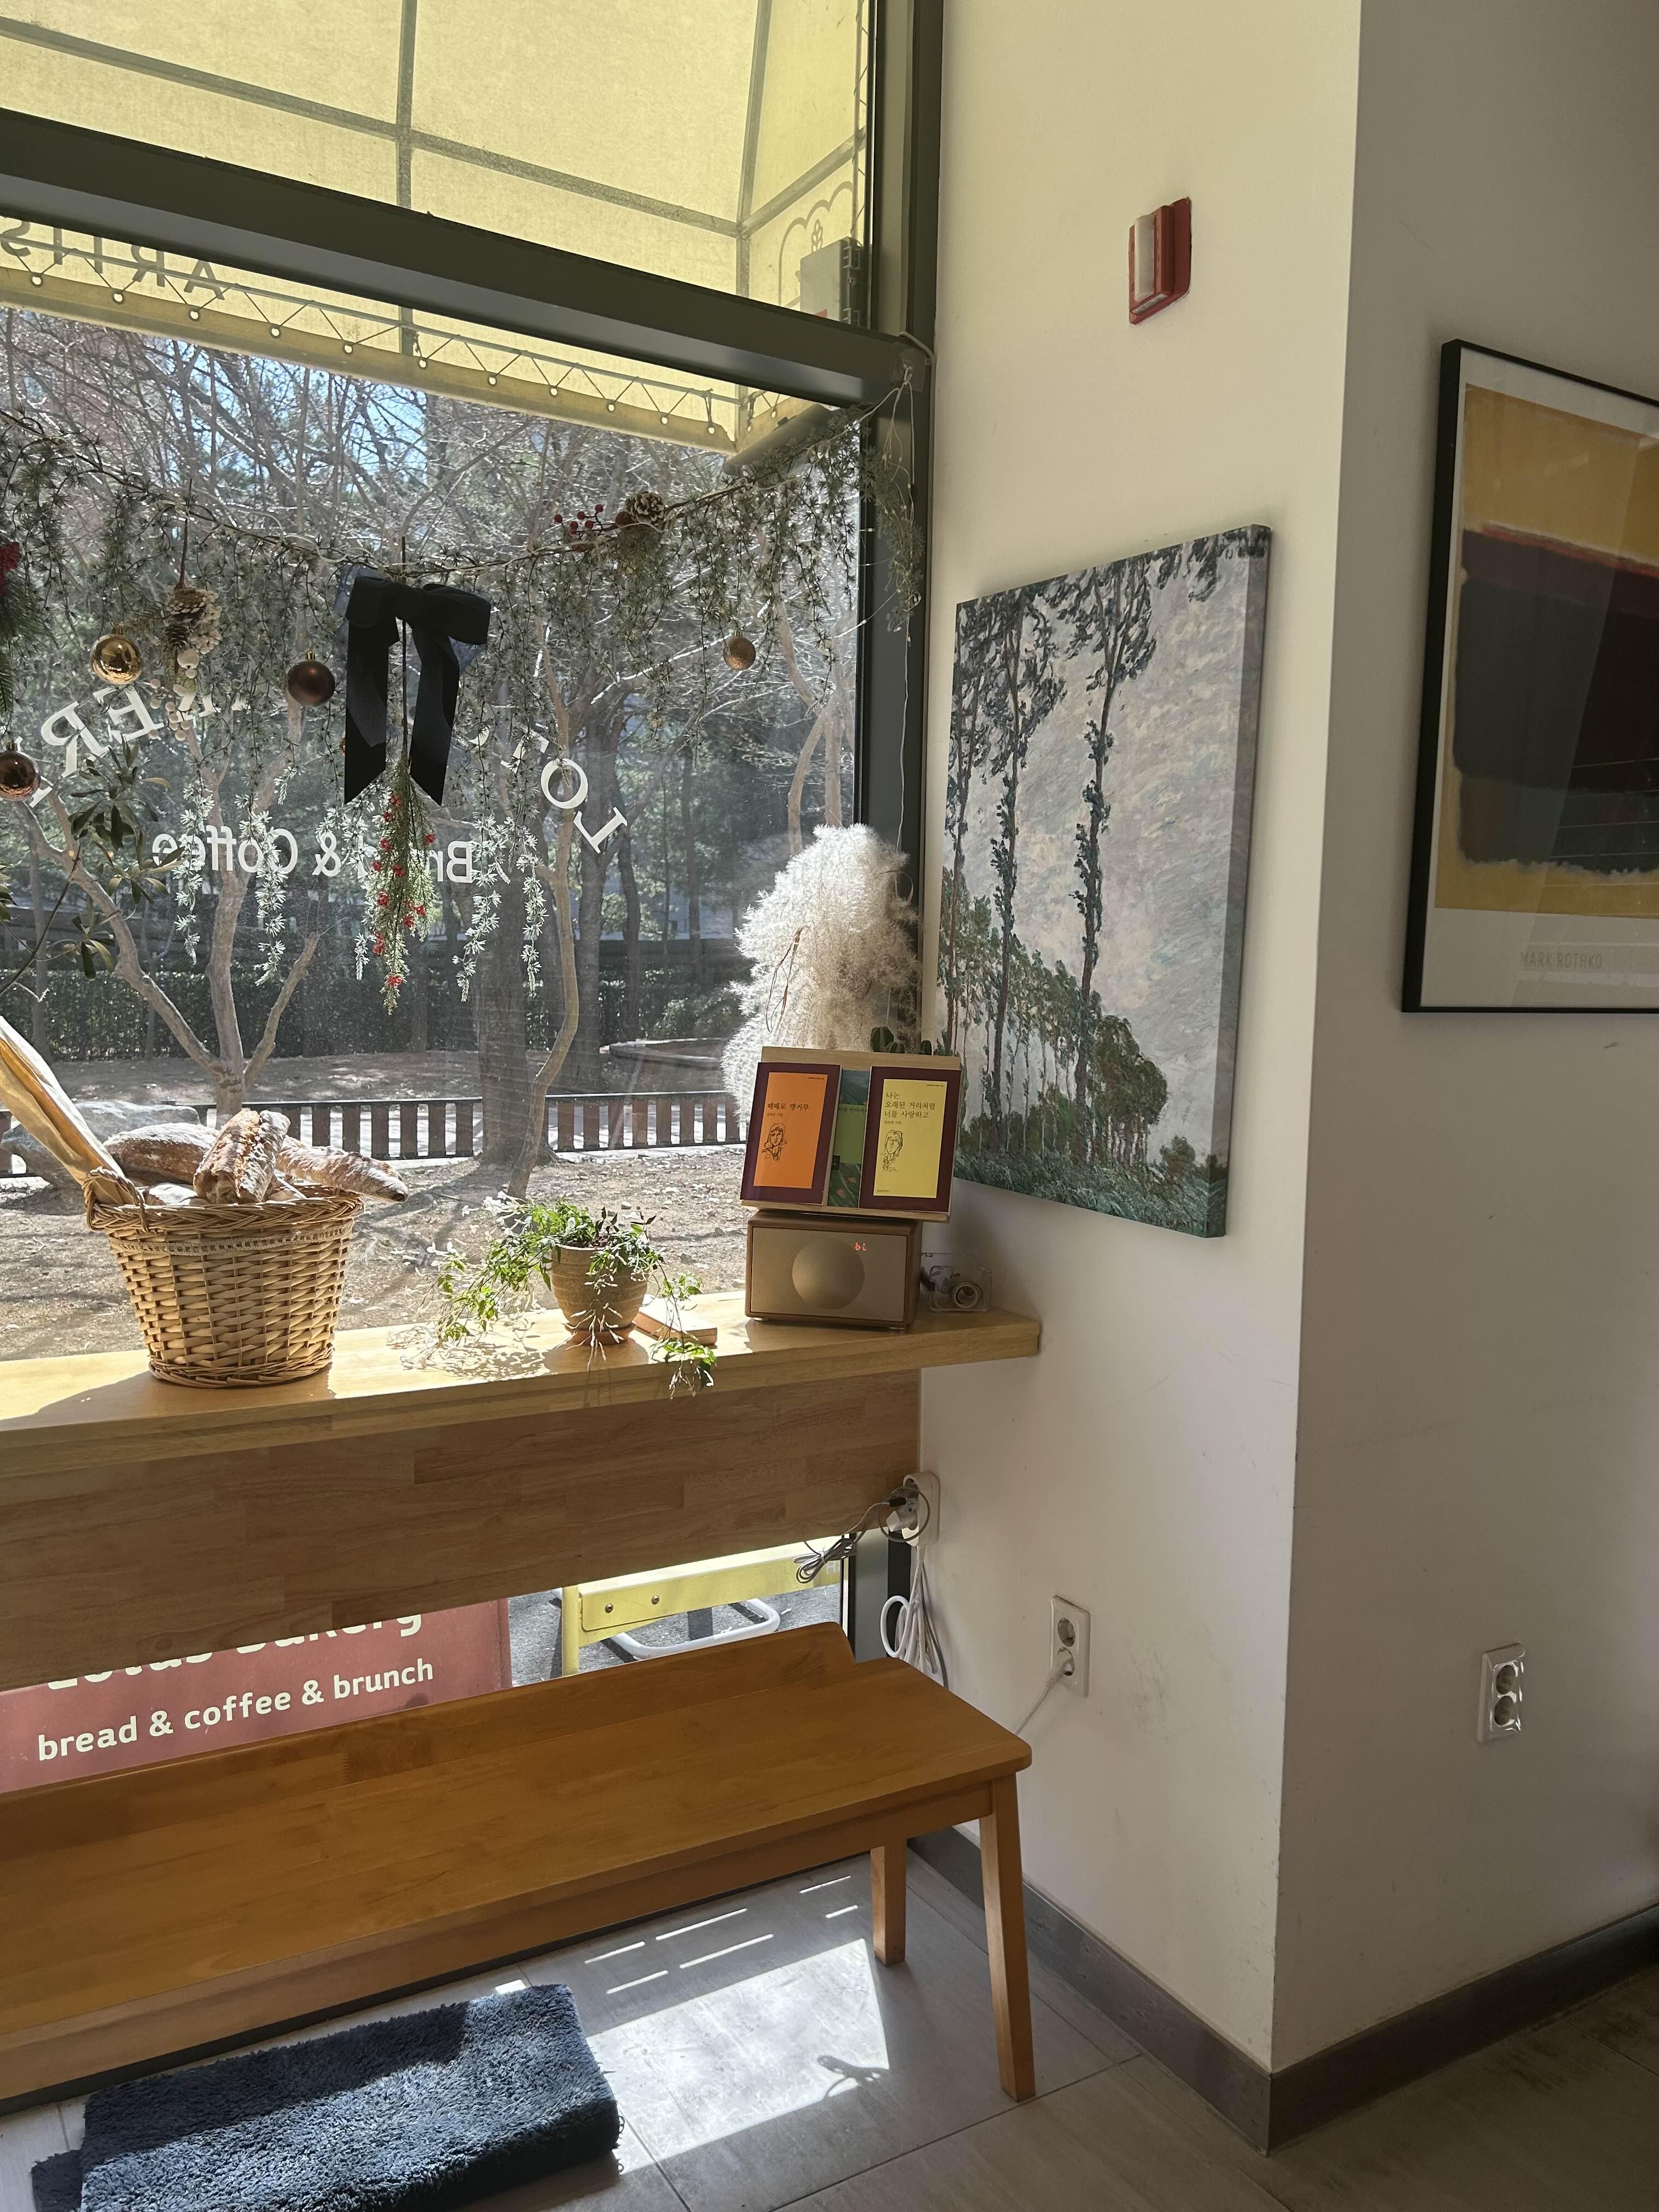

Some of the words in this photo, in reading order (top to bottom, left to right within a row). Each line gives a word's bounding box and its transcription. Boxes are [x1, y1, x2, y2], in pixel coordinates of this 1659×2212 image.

[1520, 951, 1552, 968] MARK
[1556, 952, 1602, 969] ROTHKO
[909, 1101, 935, 1110] 거리처럼
[901, 1110, 929, 1119] 사랑하고
[38, 1715, 138, 1762] bread
[149, 1709, 174, 1737] &
[184, 1692, 291, 1730] coffee
[301, 1679, 325, 1705] &
[334, 1658, 433, 1699] brunch
